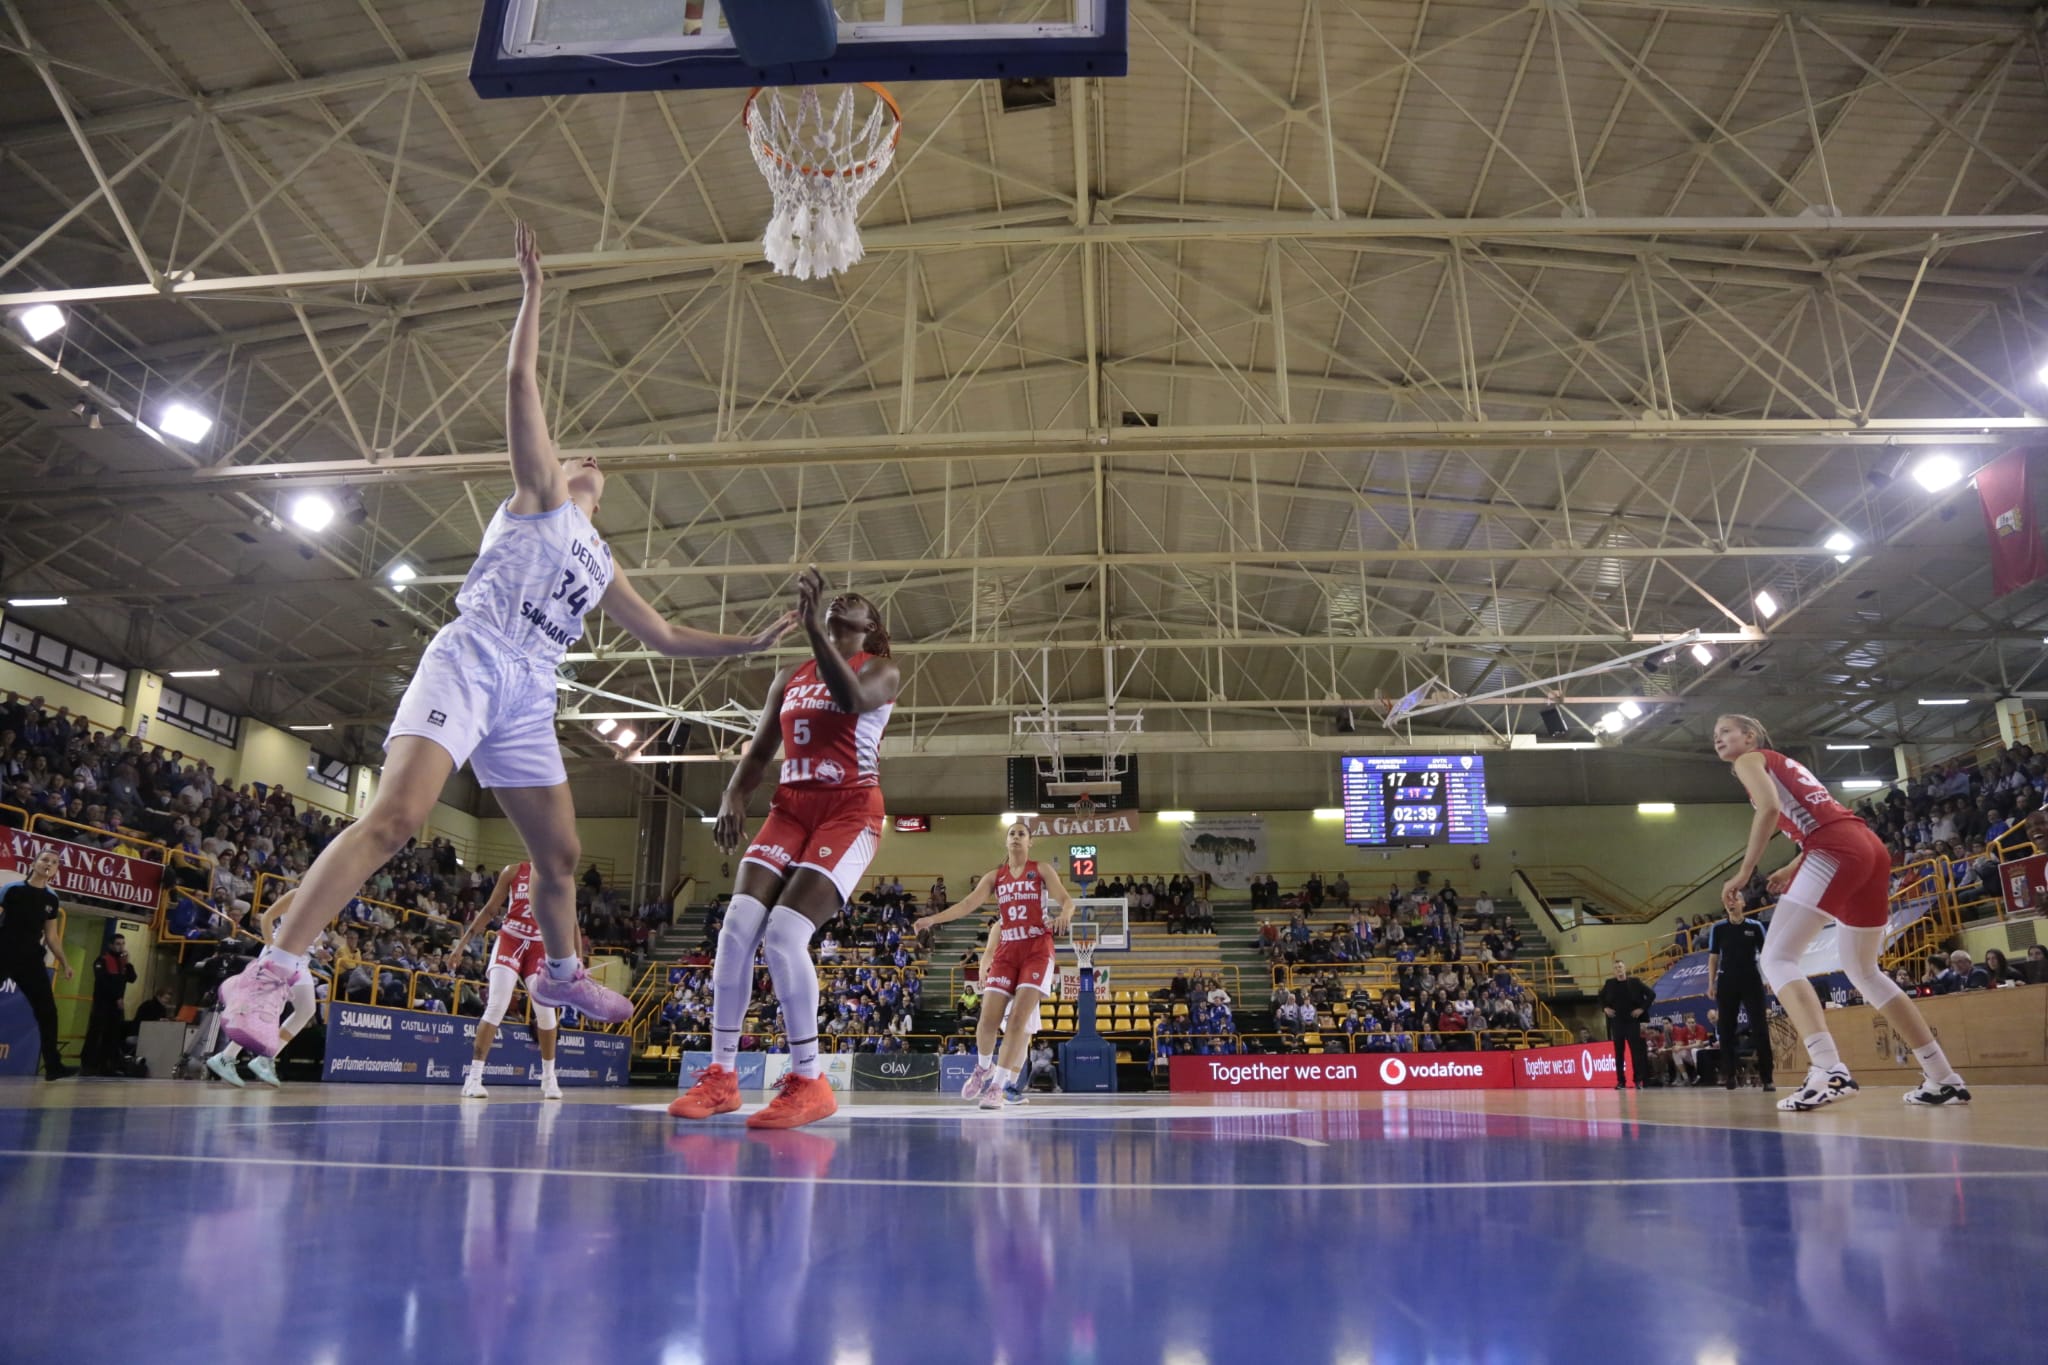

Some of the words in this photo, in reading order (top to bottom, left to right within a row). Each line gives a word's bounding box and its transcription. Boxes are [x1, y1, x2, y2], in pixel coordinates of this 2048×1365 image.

[552, 569, 589, 617] 34
[793, 719, 811, 745] 5
[1388, 773, 1406, 787] 17
[1420, 773, 1440, 787] 13
[1393, 806, 1437, 821] 02:39
[1053, 816, 1132, 836] GACETA
[1396, 823, 1405, 836] 2
[1428, 823, 1436, 835] 1
[1071, 846, 1097, 856] 02:39
[1073, 861, 1094, 875] 12
[66, 871, 153, 904] HUMANIDAD
[997, 881, 1037, 897] DVTK
[1008, 905, 1028, 921] 92
[340, 1010, 392, 1030] SALAMANCA
[401, 1020, 430, 1033] CASTILLA
[432, 1024, 438, 1034] Y
[437, 1021, 454, 1035] LEÓN
[1209, 1063, 1289, 1085] Together
[1294, 1067, 1321, 1080] we
[1325, 1064, 1357, 1079] can
[1409, 1061, 1483, 1078] vodafone
[1523, 1057, 1552, 1081] Together
[1552, 1060, 1563, 1075] we
[1563, 1058, 1576, 1074] can
